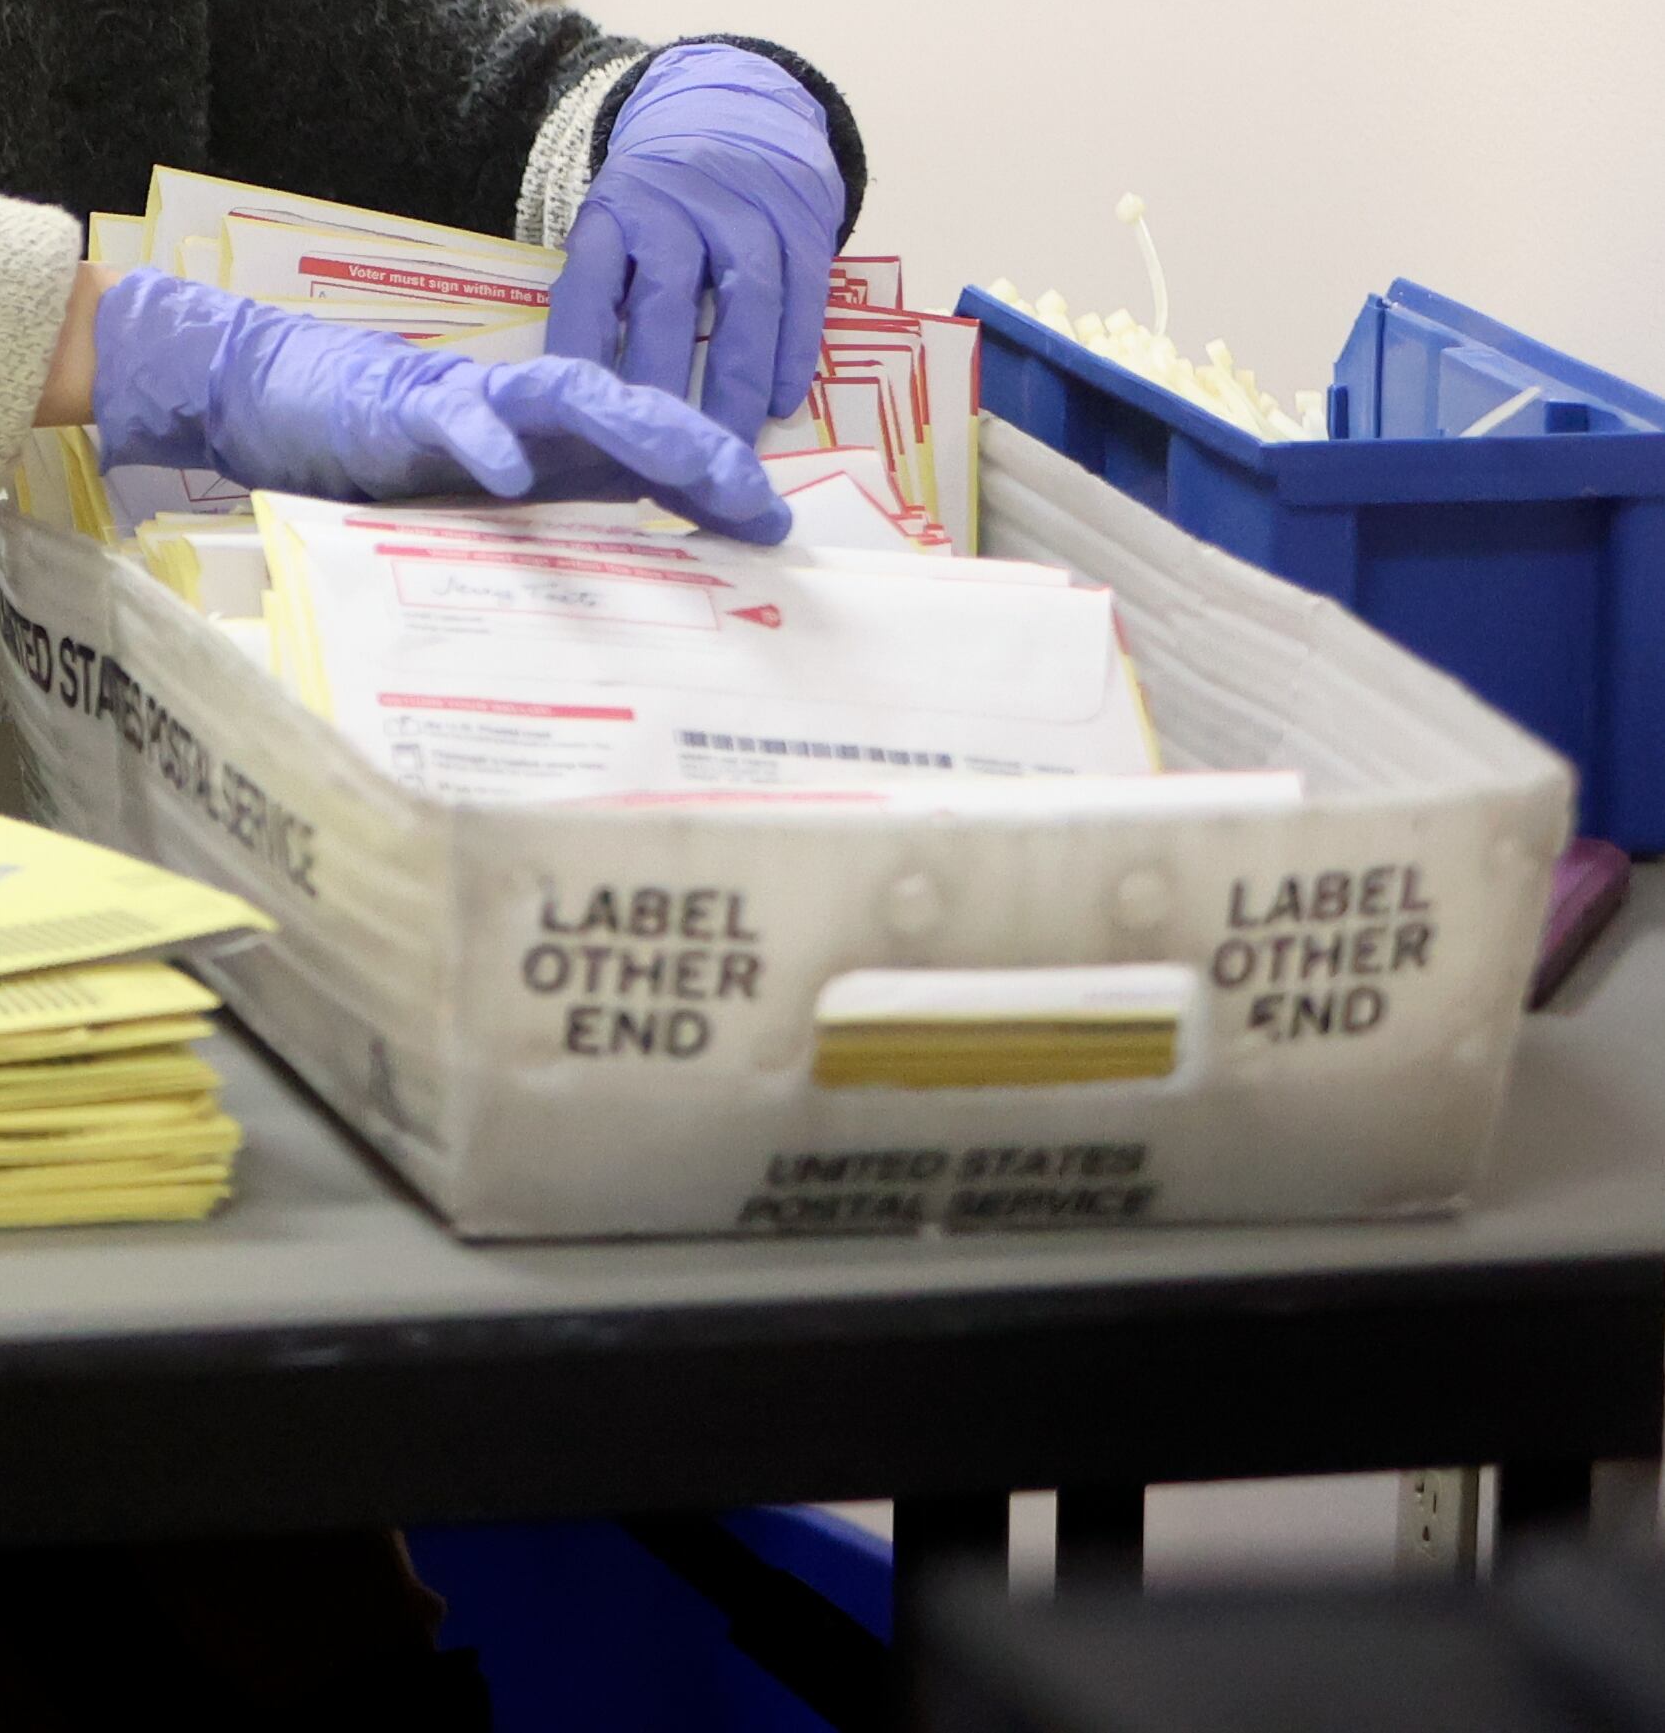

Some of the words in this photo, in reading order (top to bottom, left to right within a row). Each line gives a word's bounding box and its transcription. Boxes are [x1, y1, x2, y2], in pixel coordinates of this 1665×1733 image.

[348, 265, 386, 281] Voter
[390, 272, 425, 287] must
[428, 277, 459, 293] sign
[463, 283, 506, 298] within
[510, 288, 532, 302] the
[539, 878, 758, 943] LABEL
[1227, 863, 1431, 929] LABEL
[522, 942, 761, 999] OTHER
[1211, 921, 1435, 989] OTHER
[565, 1004, 712, 1058] END
[1246, 984, 1387, 1044] END
